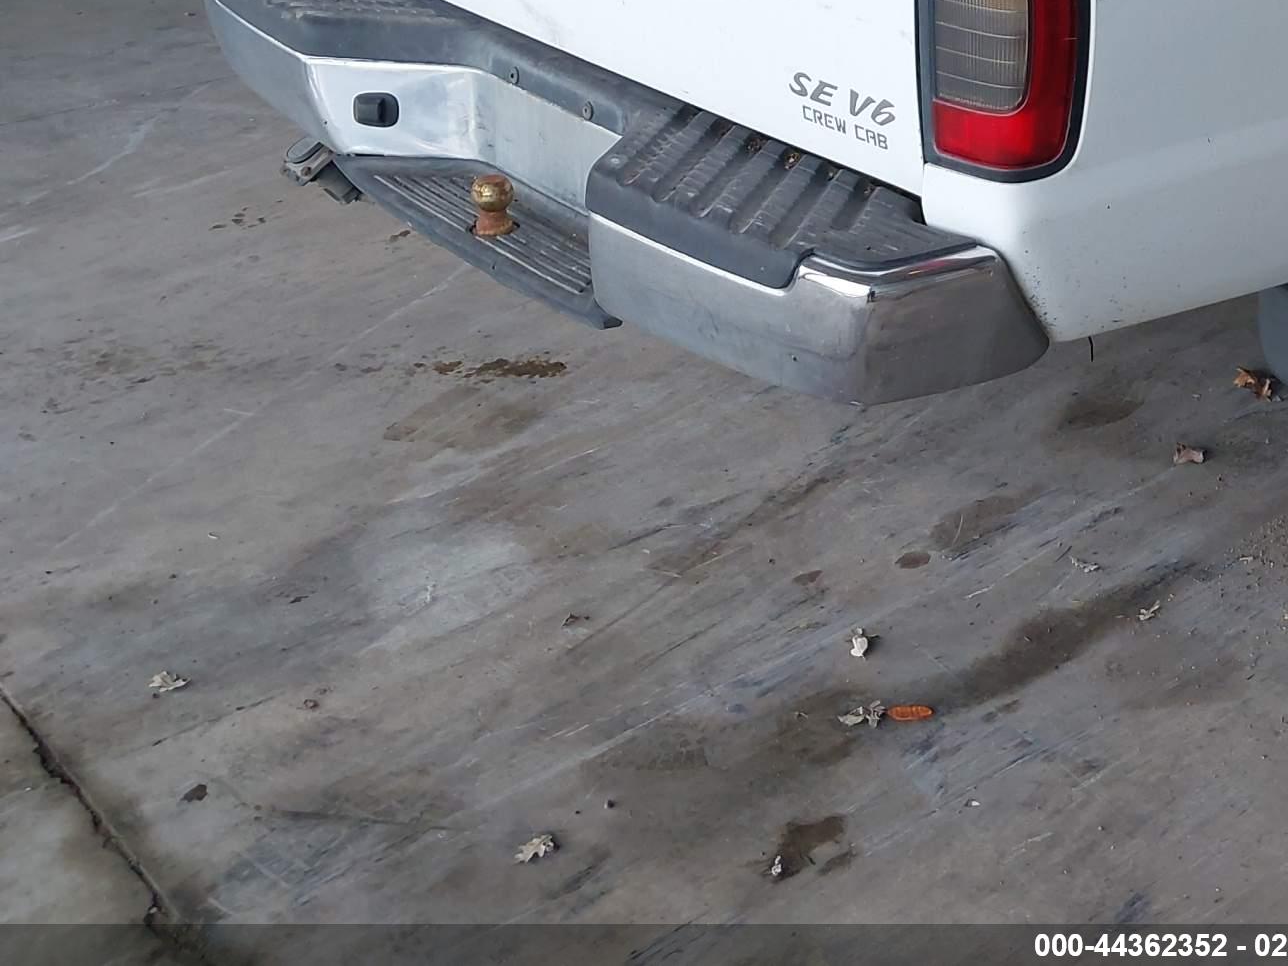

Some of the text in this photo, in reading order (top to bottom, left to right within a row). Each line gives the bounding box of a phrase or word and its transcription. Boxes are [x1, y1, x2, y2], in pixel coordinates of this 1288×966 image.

[788, 71, 896, 126] SE V6
[802, 104, 889, 150] CREW CAB
